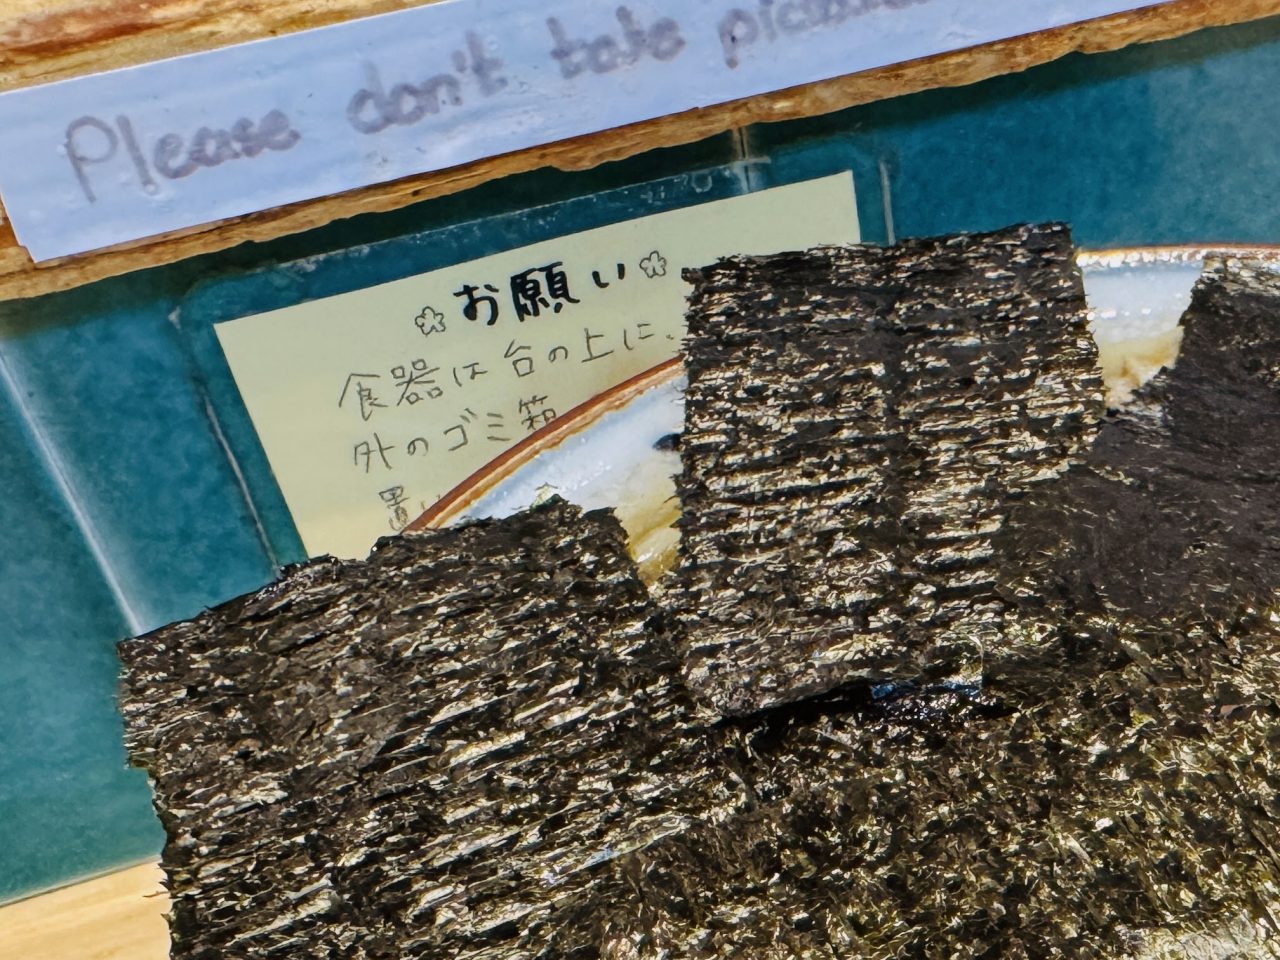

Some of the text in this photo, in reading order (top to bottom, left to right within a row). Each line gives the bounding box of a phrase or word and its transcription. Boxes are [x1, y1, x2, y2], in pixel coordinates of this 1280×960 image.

[64, 115, 301, 203] Please
[347, 30, 508, 135] don't
[453, 261, 627, 326] お願い
